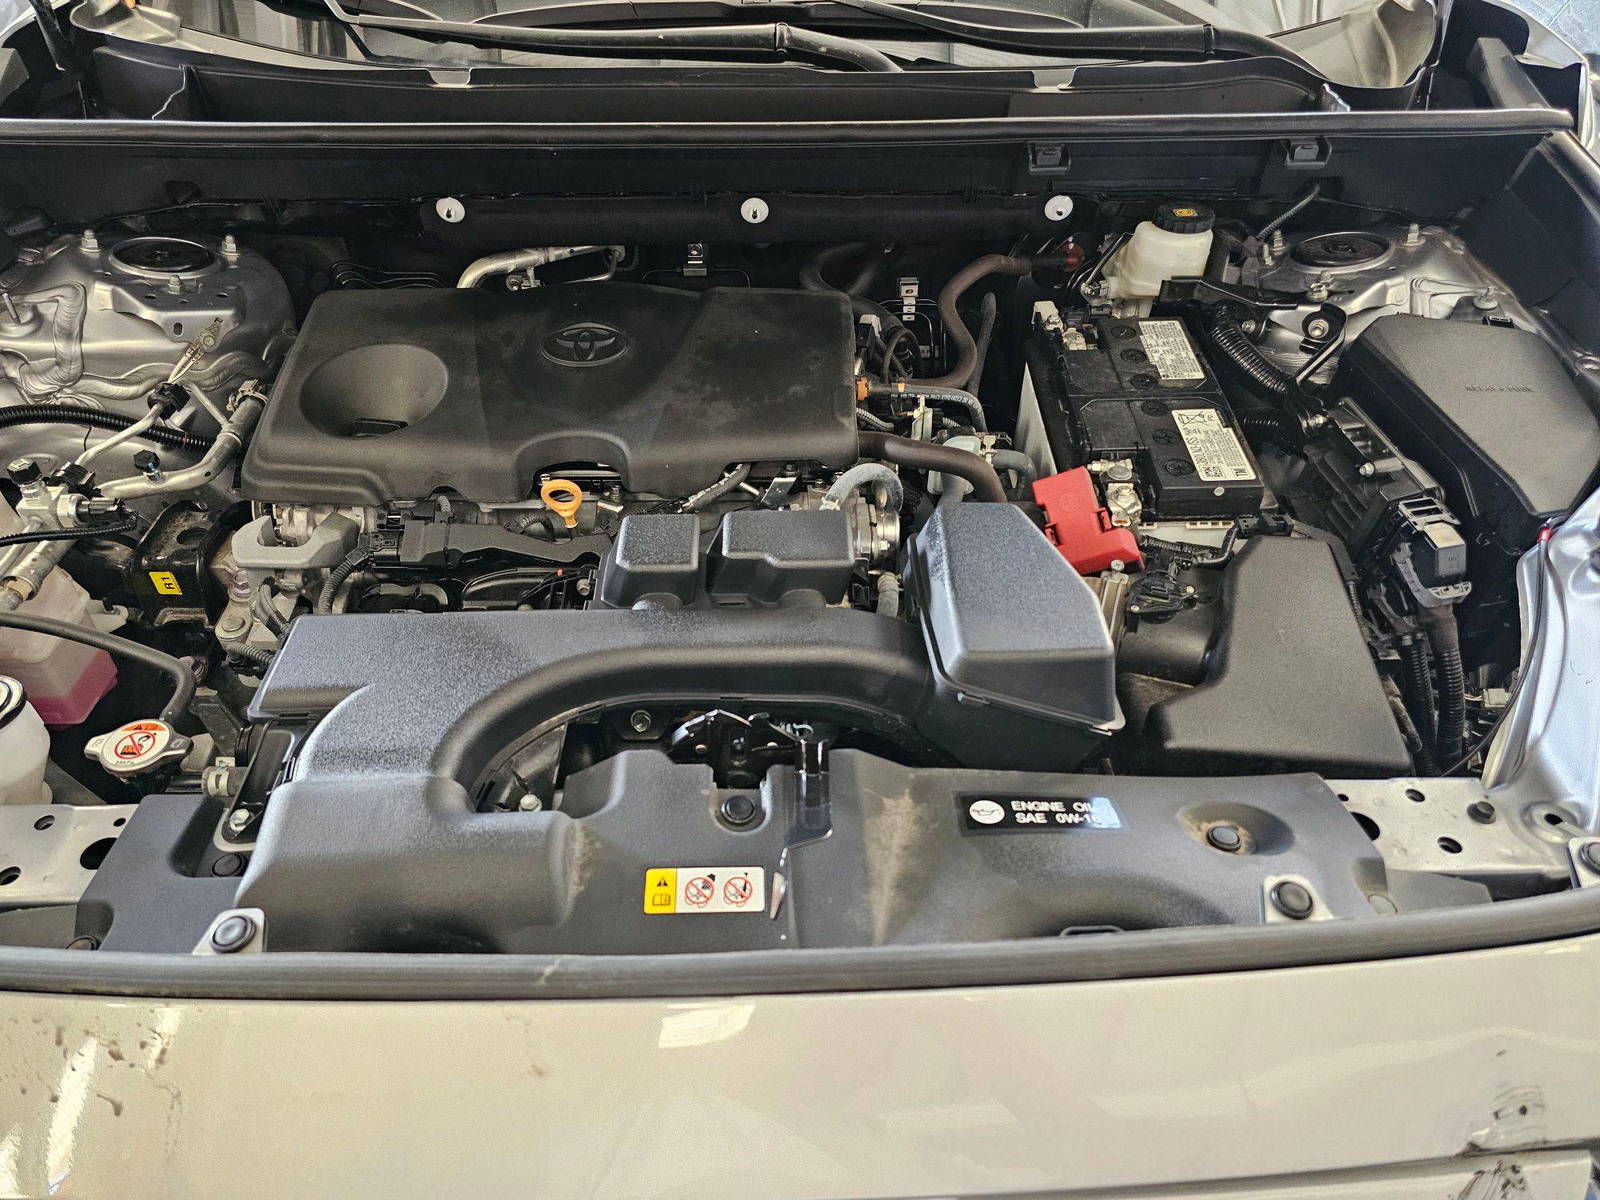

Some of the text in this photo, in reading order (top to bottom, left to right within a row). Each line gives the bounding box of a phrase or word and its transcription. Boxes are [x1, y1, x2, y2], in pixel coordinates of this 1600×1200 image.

[161, 577, 175, 590] R1
[1011, 800, 1066, 812] ENGINE
[1015, 812, 1048, 824] SAE
